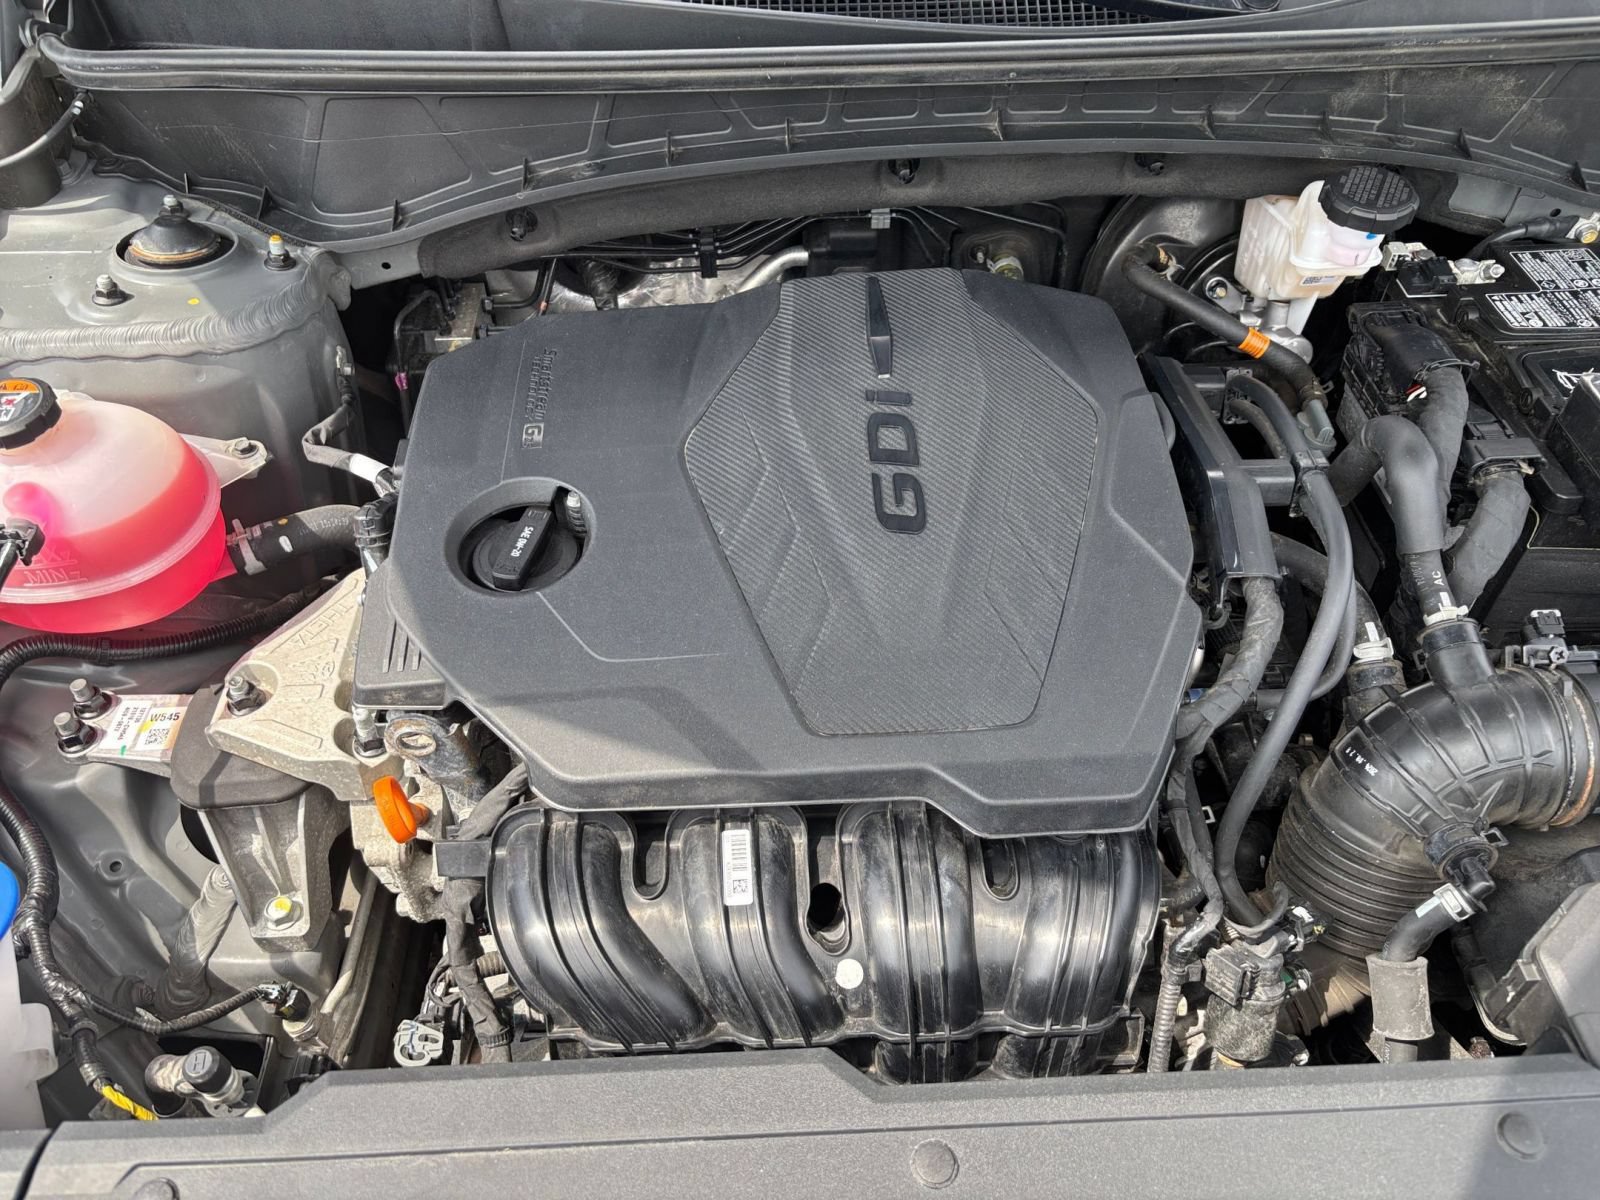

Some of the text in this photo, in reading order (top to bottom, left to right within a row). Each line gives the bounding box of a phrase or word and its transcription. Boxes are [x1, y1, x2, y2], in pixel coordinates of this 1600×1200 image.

[534, 347, 558, 421] Smartstream
[865, 389, 927, 536] GDi
[510, 526, 534, 557] SAE 0W-20
[24, 568, 69, 585] MIN
[1431, 570, 1445, 586] AC
[151, 711, 181, 722] W545
